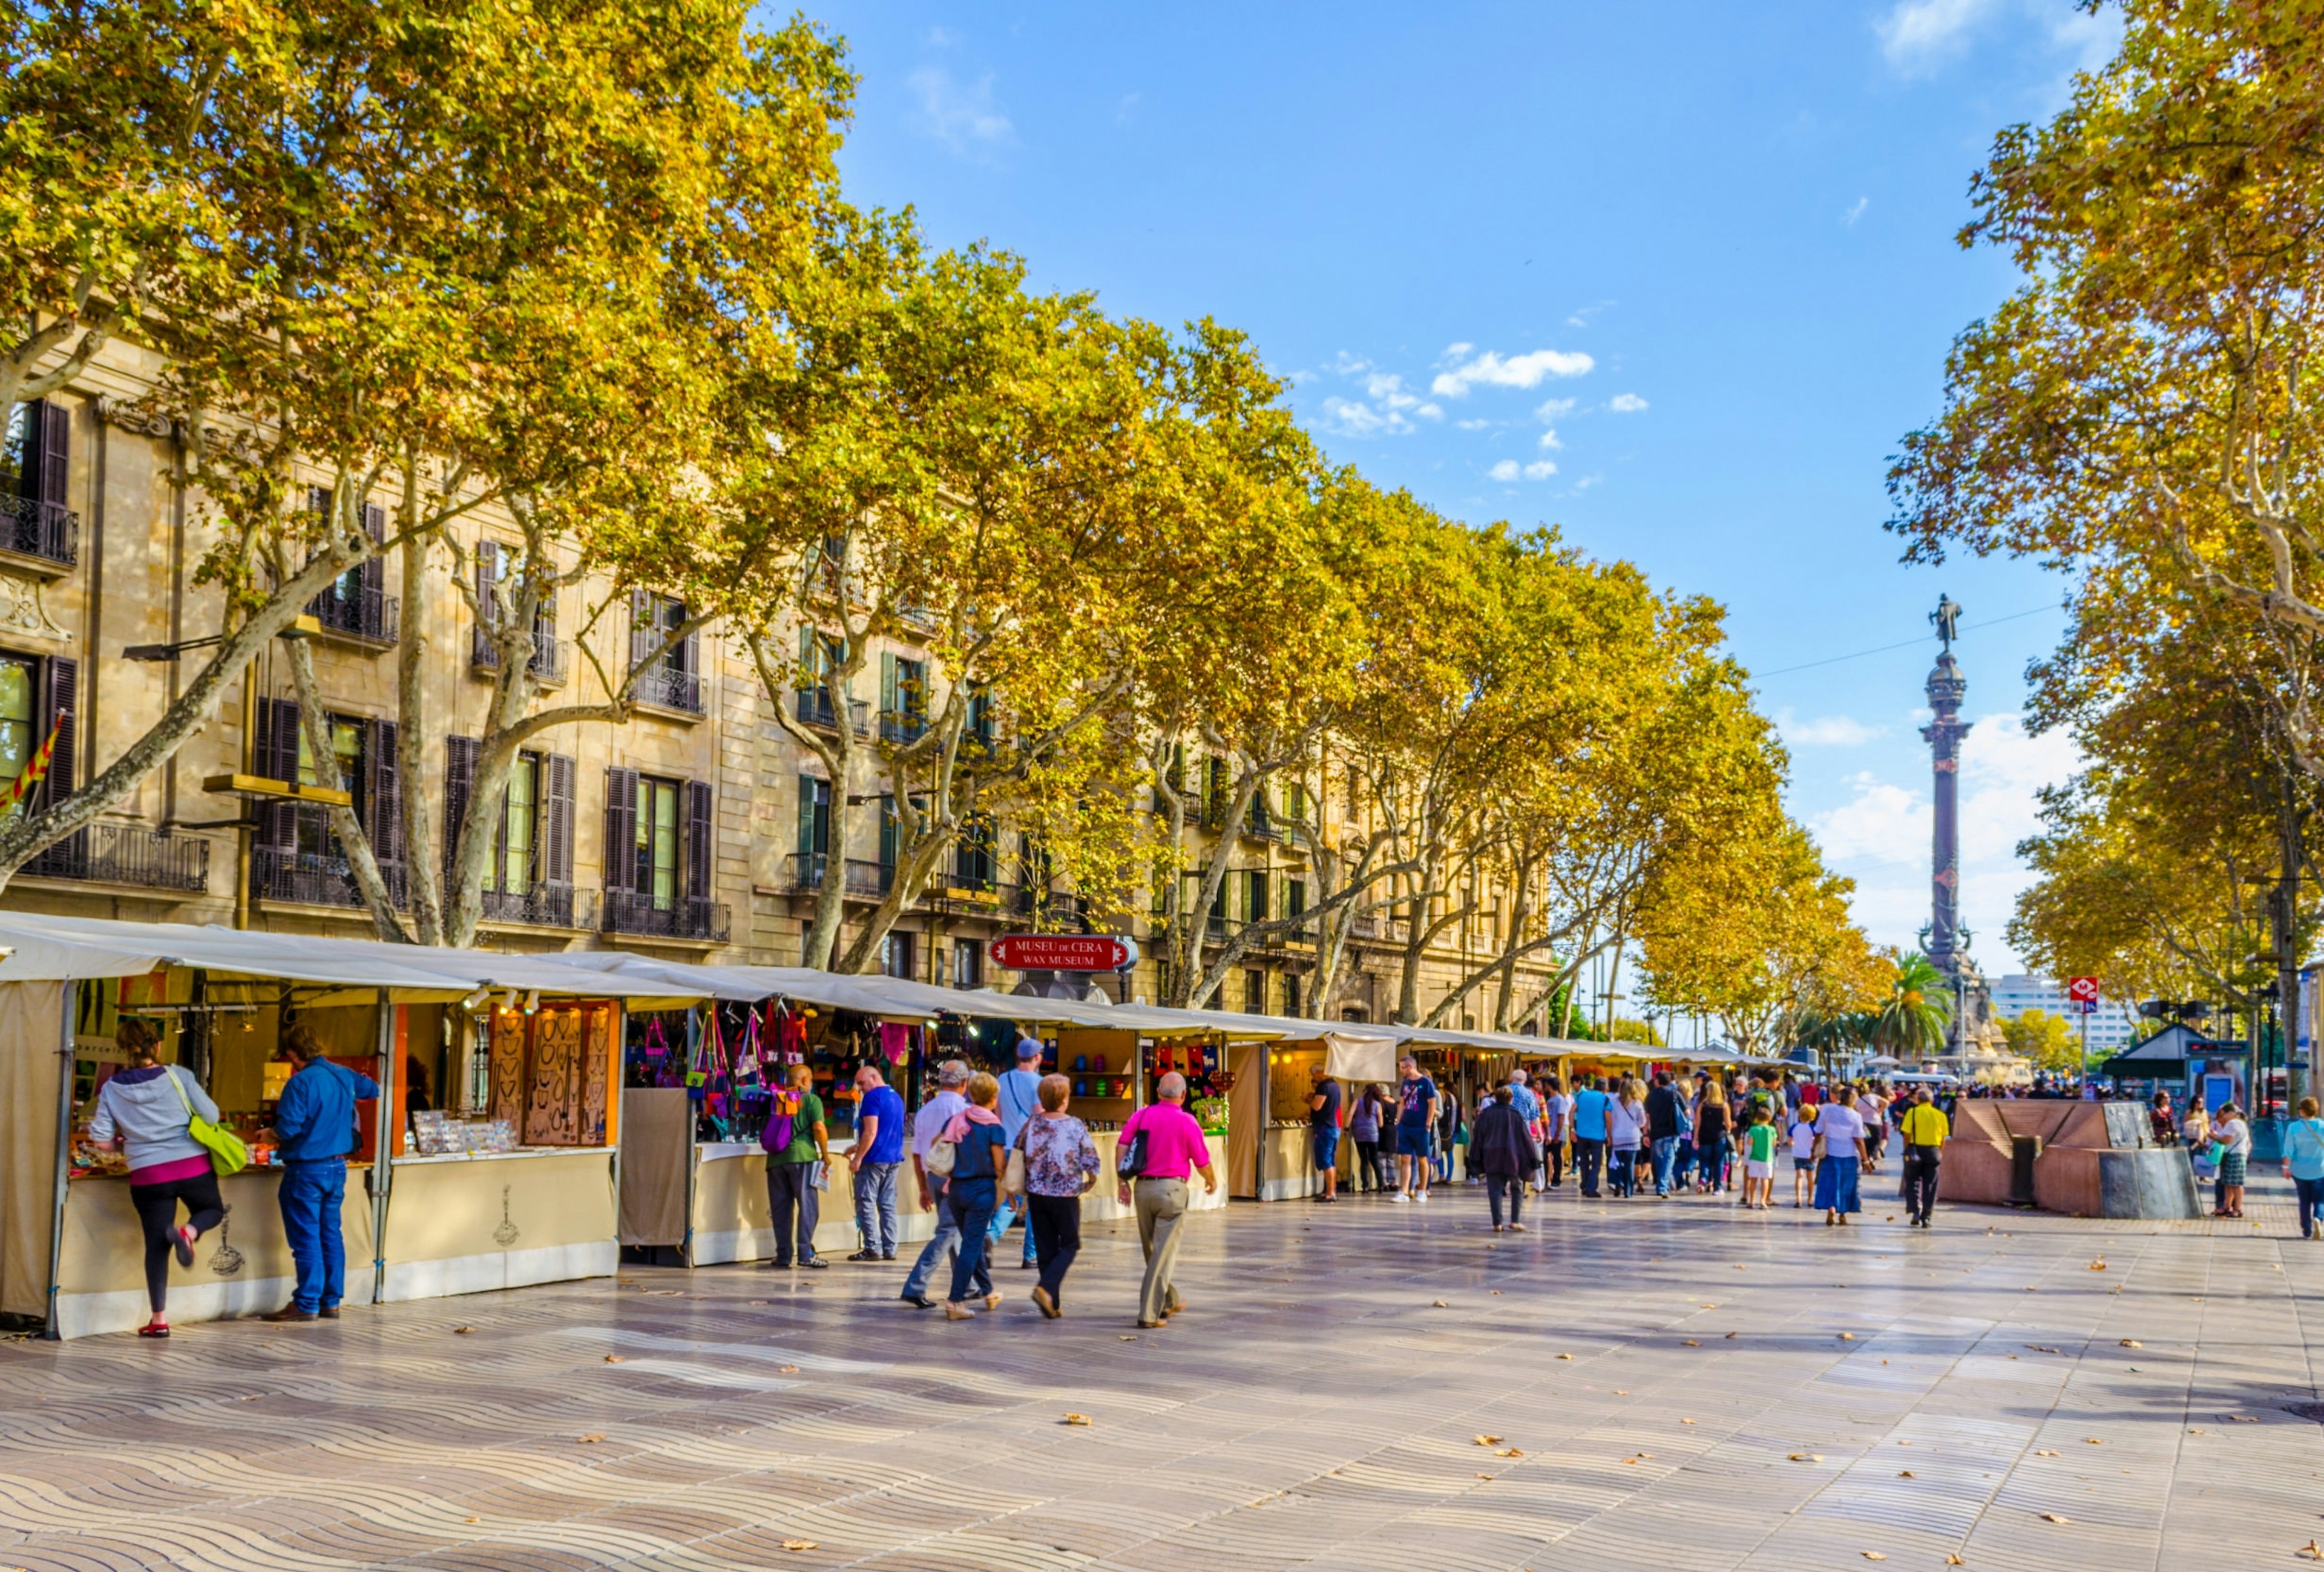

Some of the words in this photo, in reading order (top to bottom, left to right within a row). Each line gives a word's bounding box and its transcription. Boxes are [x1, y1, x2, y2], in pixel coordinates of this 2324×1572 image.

[1016, 941, 1057, 952] MUSEU
[1071, 942, 1103, 953] CERA
[1023, 955, 1046, 964] WAX
[1049, 956, 1094, 966] MUSEUM
